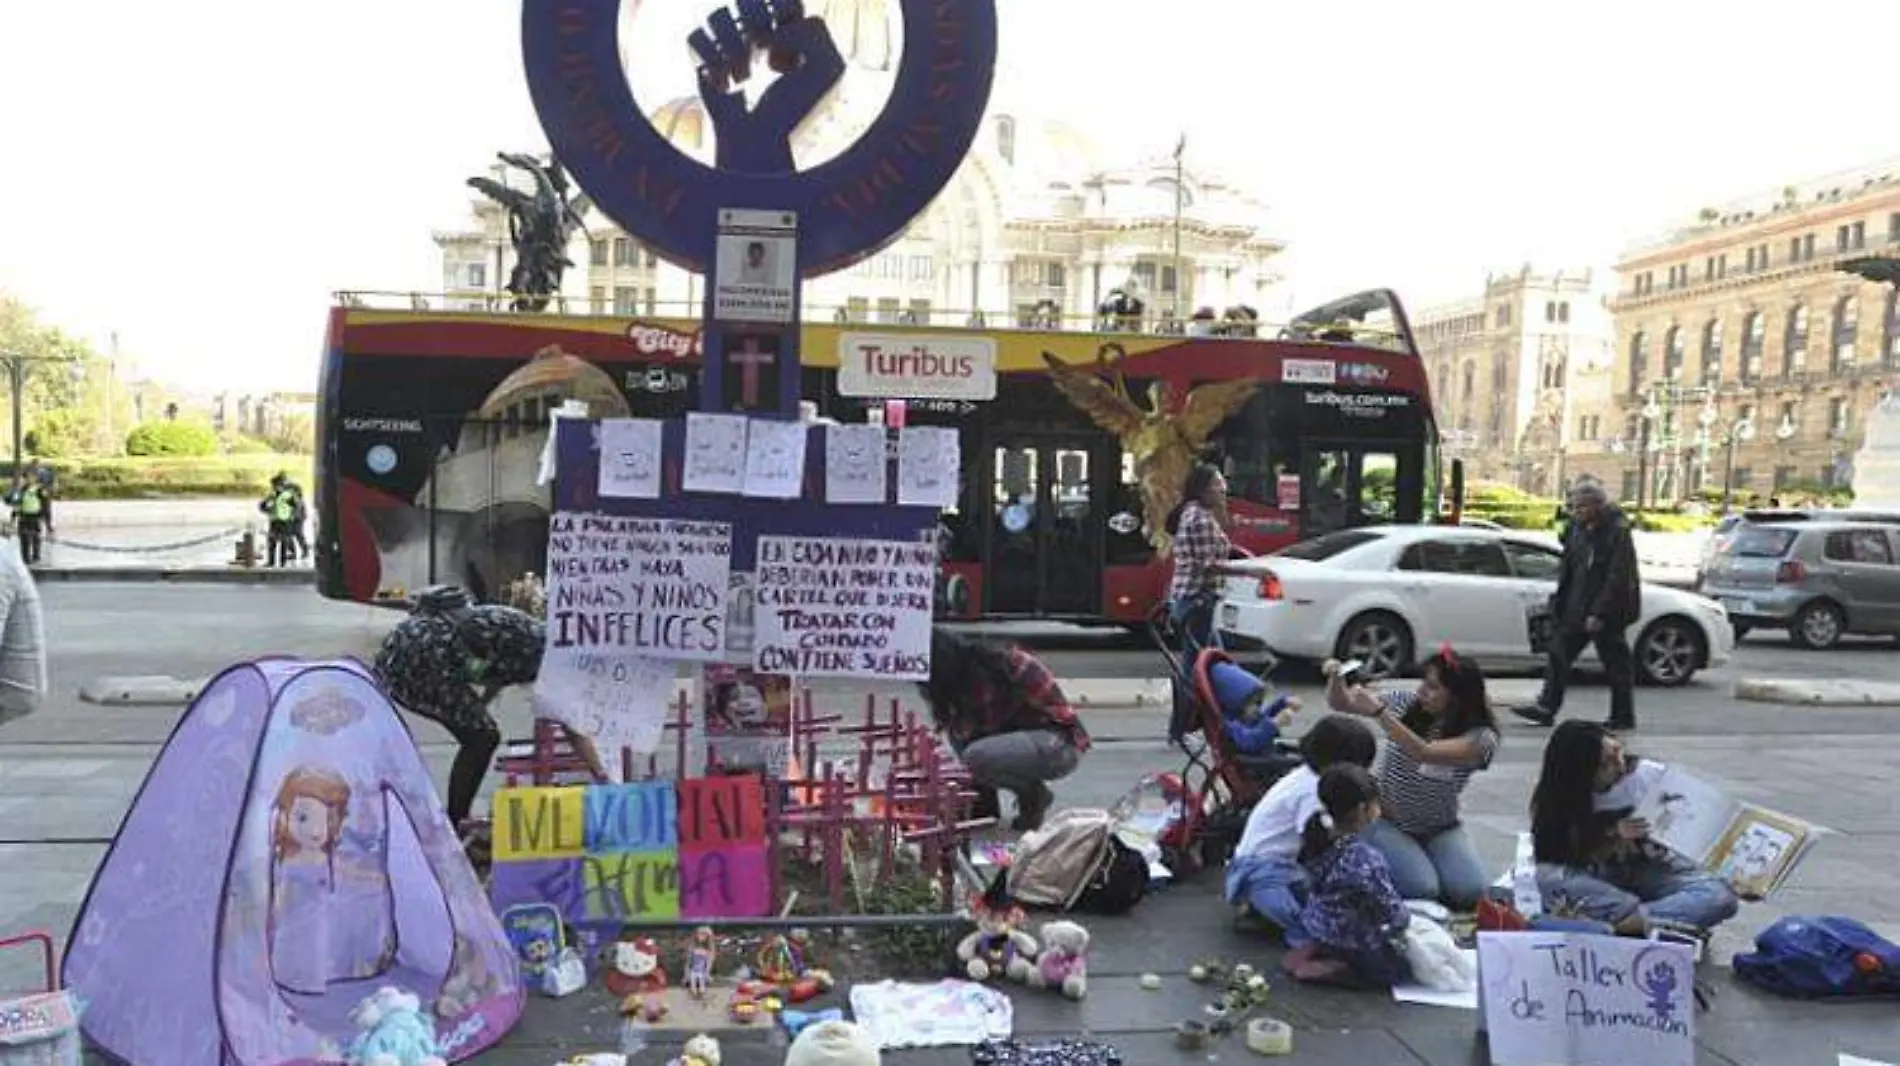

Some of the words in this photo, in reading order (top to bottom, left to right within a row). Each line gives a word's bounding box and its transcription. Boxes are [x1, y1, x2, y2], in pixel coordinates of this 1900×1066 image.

[629, 323, 693, 358] City
[858, 344, 974, 379] Turibus
[631, 582, 646, 608] Y
[553, 611, 723, 652] INFELICES
[1531, 942, 1628, 988] Taller
[1511, 979, 1546, 1021] de
